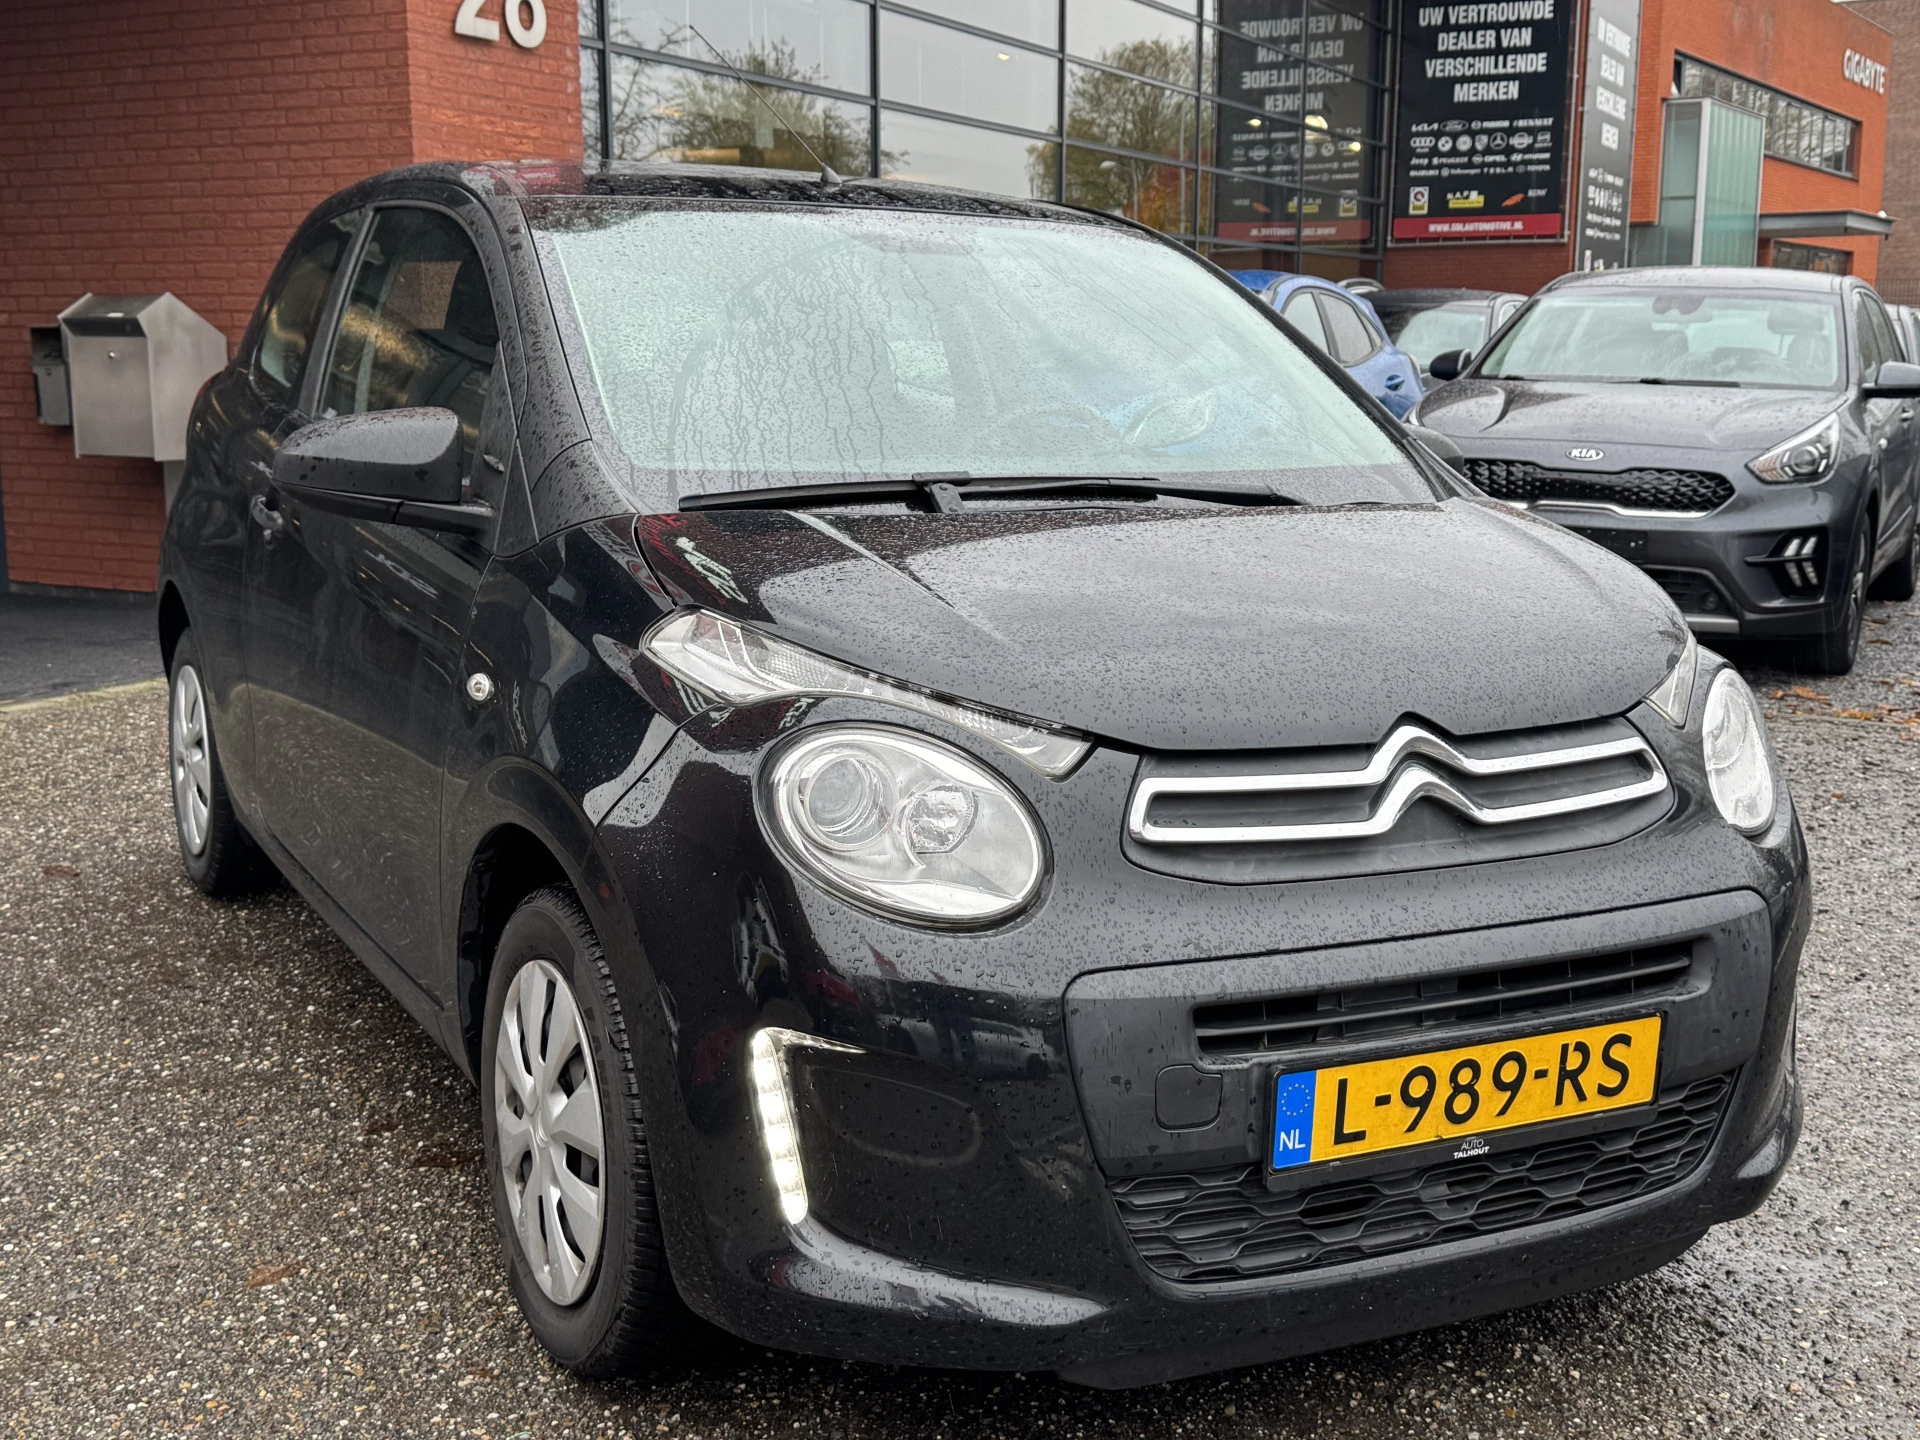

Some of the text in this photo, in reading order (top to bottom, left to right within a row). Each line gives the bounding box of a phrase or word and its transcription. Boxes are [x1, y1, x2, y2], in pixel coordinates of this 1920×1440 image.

[1418, 0, 1555, 26] UW VERTROUWDE
[1437, 26, 1533, 52] DEALER VAN
[1425, 52, 1548, 78] VERSCHILLENDE
[1843, 48, 1886, 95] GIGABYTE
[1453, 80, 1520, 103] MERKEN
[1571, 448, 1597, 459] KIA
[1332, 1032, 1633, 1146] L-989-RS
[1279, 1129, 1306, 1152] NL
[1461, 1139, 1484, 1151] AUTO
[1453, 1146, 1490, 1160] TALHOUT
